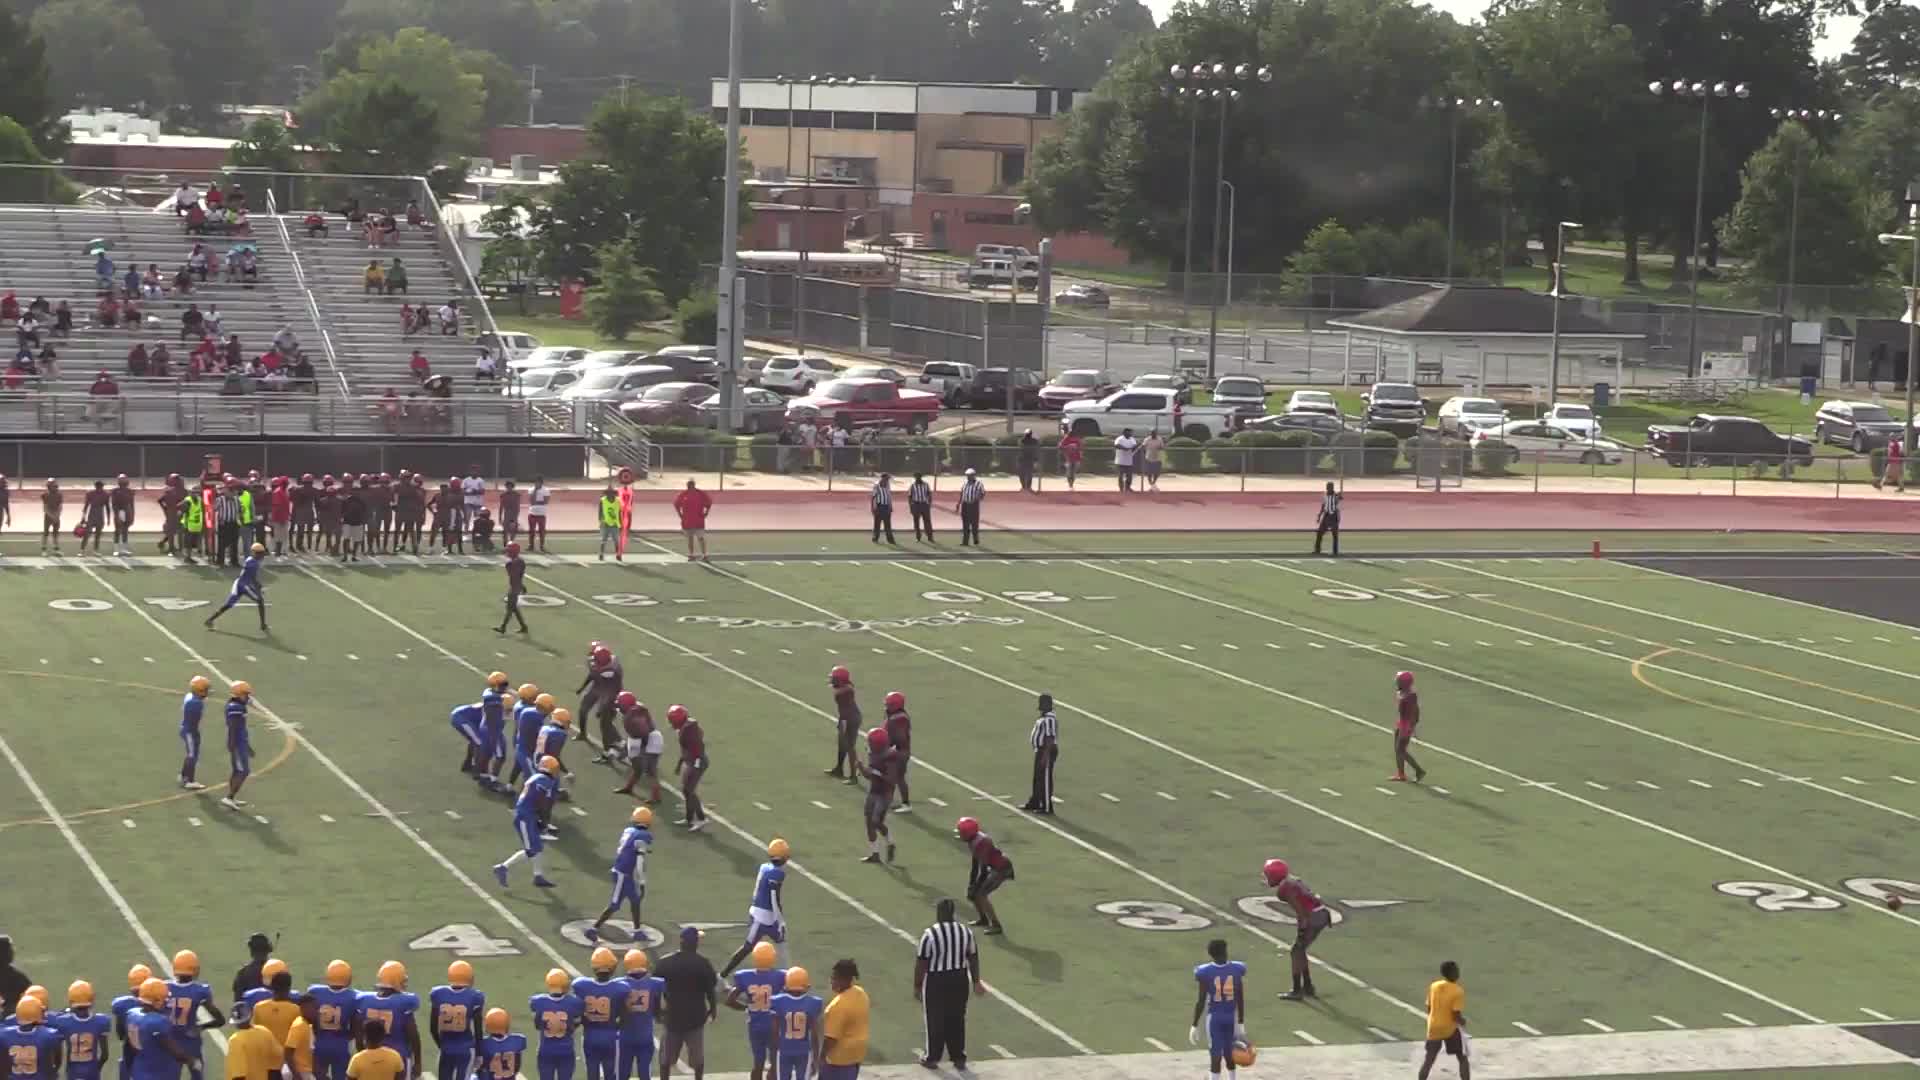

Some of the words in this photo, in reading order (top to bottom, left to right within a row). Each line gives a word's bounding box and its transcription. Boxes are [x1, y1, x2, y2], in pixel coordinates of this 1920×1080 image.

[1213, 975, 1234, 1001] 14
[785, 1011, 807, 1039] 19
[69, 1032, 94, 1062] 12
